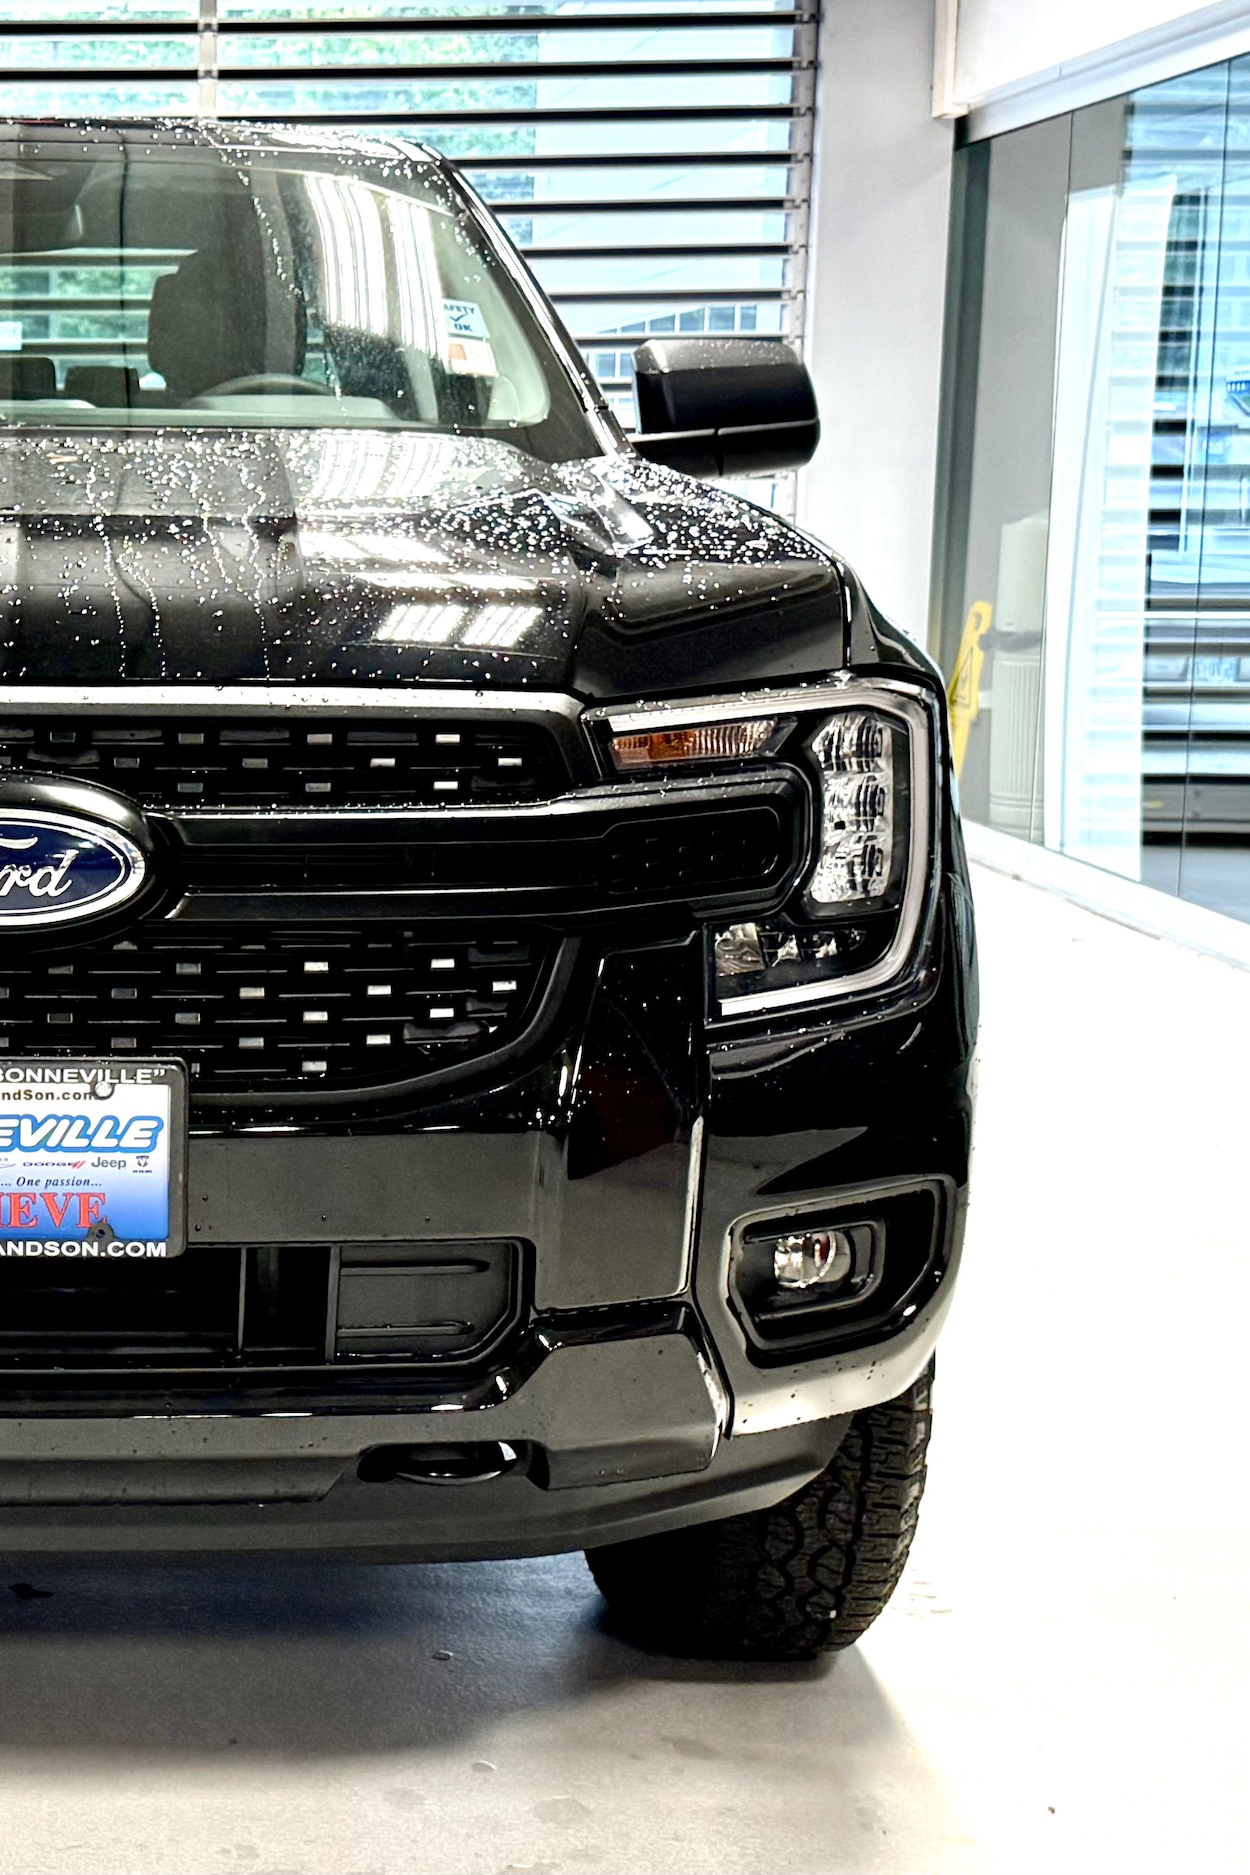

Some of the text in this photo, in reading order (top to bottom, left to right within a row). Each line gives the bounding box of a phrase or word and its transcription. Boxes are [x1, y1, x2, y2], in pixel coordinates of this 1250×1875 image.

[442, 303, 475, 314] AFETY
[453, 322, 473, 332] OK
[91, 1156, 127, 1170] Jeep
[16, 1176, 41, 1187] One
[44, 1176, 102, 1190] passion...
